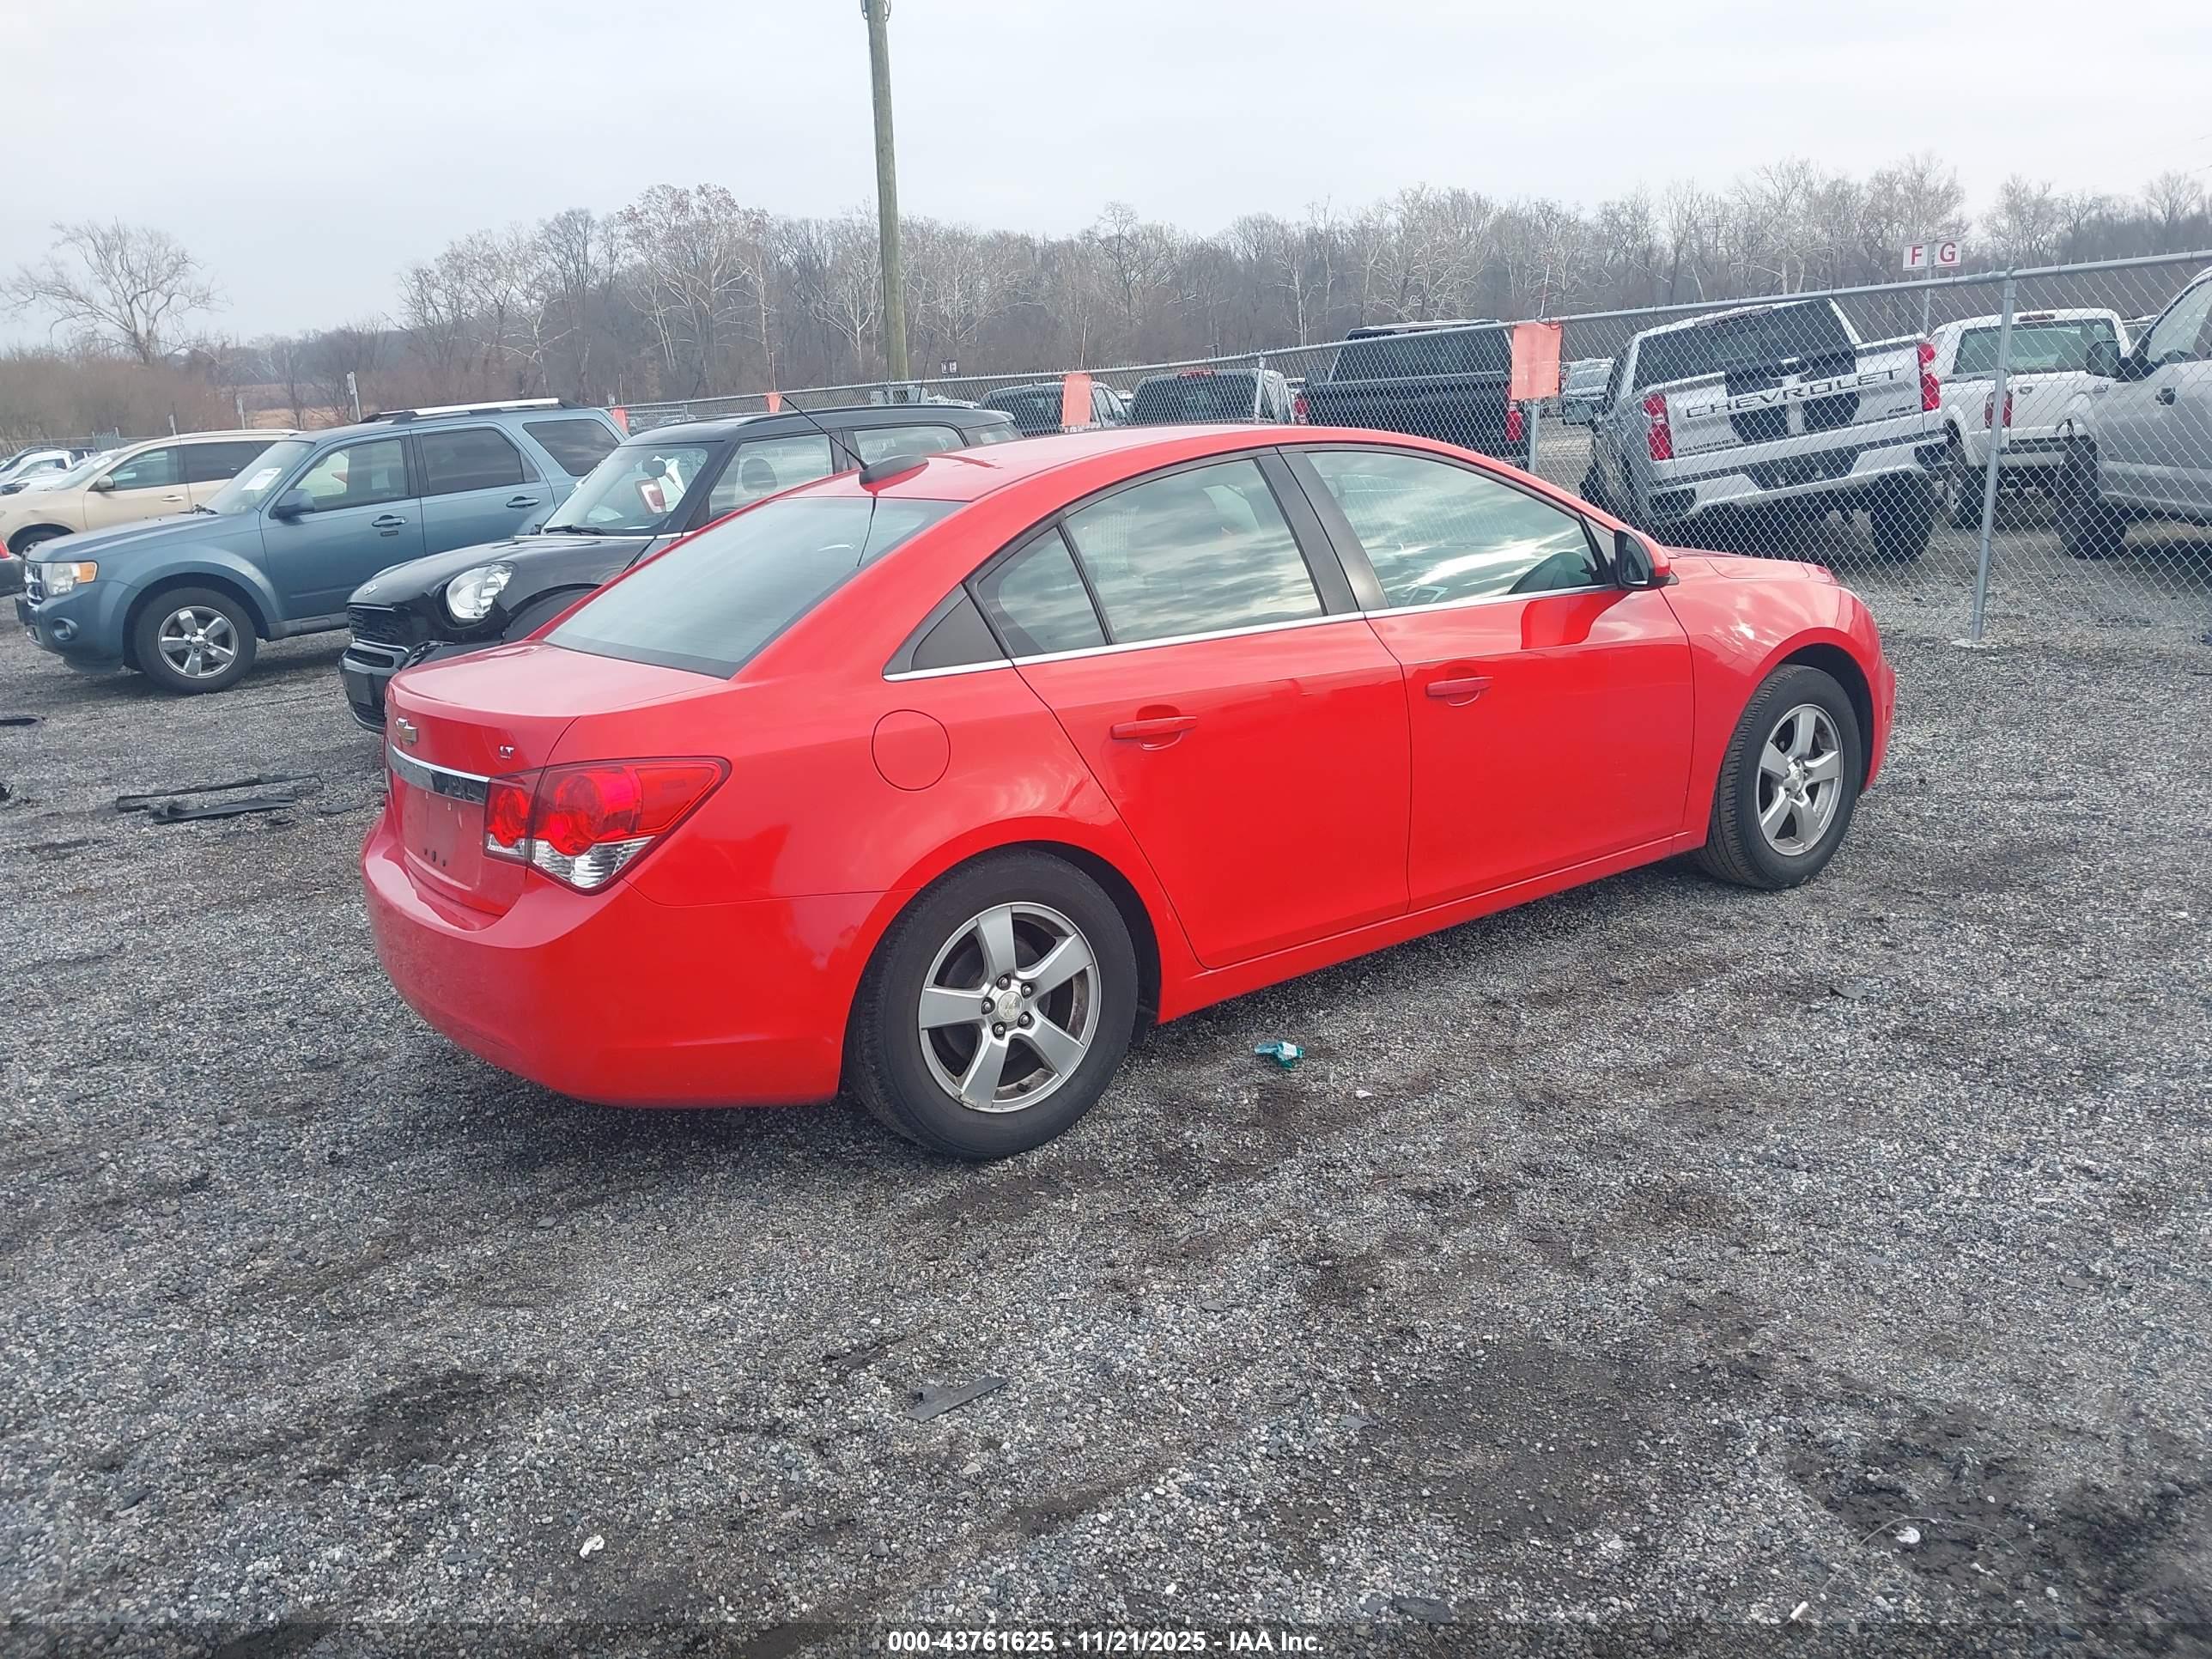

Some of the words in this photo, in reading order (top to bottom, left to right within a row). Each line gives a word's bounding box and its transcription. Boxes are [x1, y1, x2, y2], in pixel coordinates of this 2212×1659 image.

[1911, 246, 1923, 265] F
[1939, 241, 1956, 262] G
[1686, 368, 1902, 418] CHEVROLET
